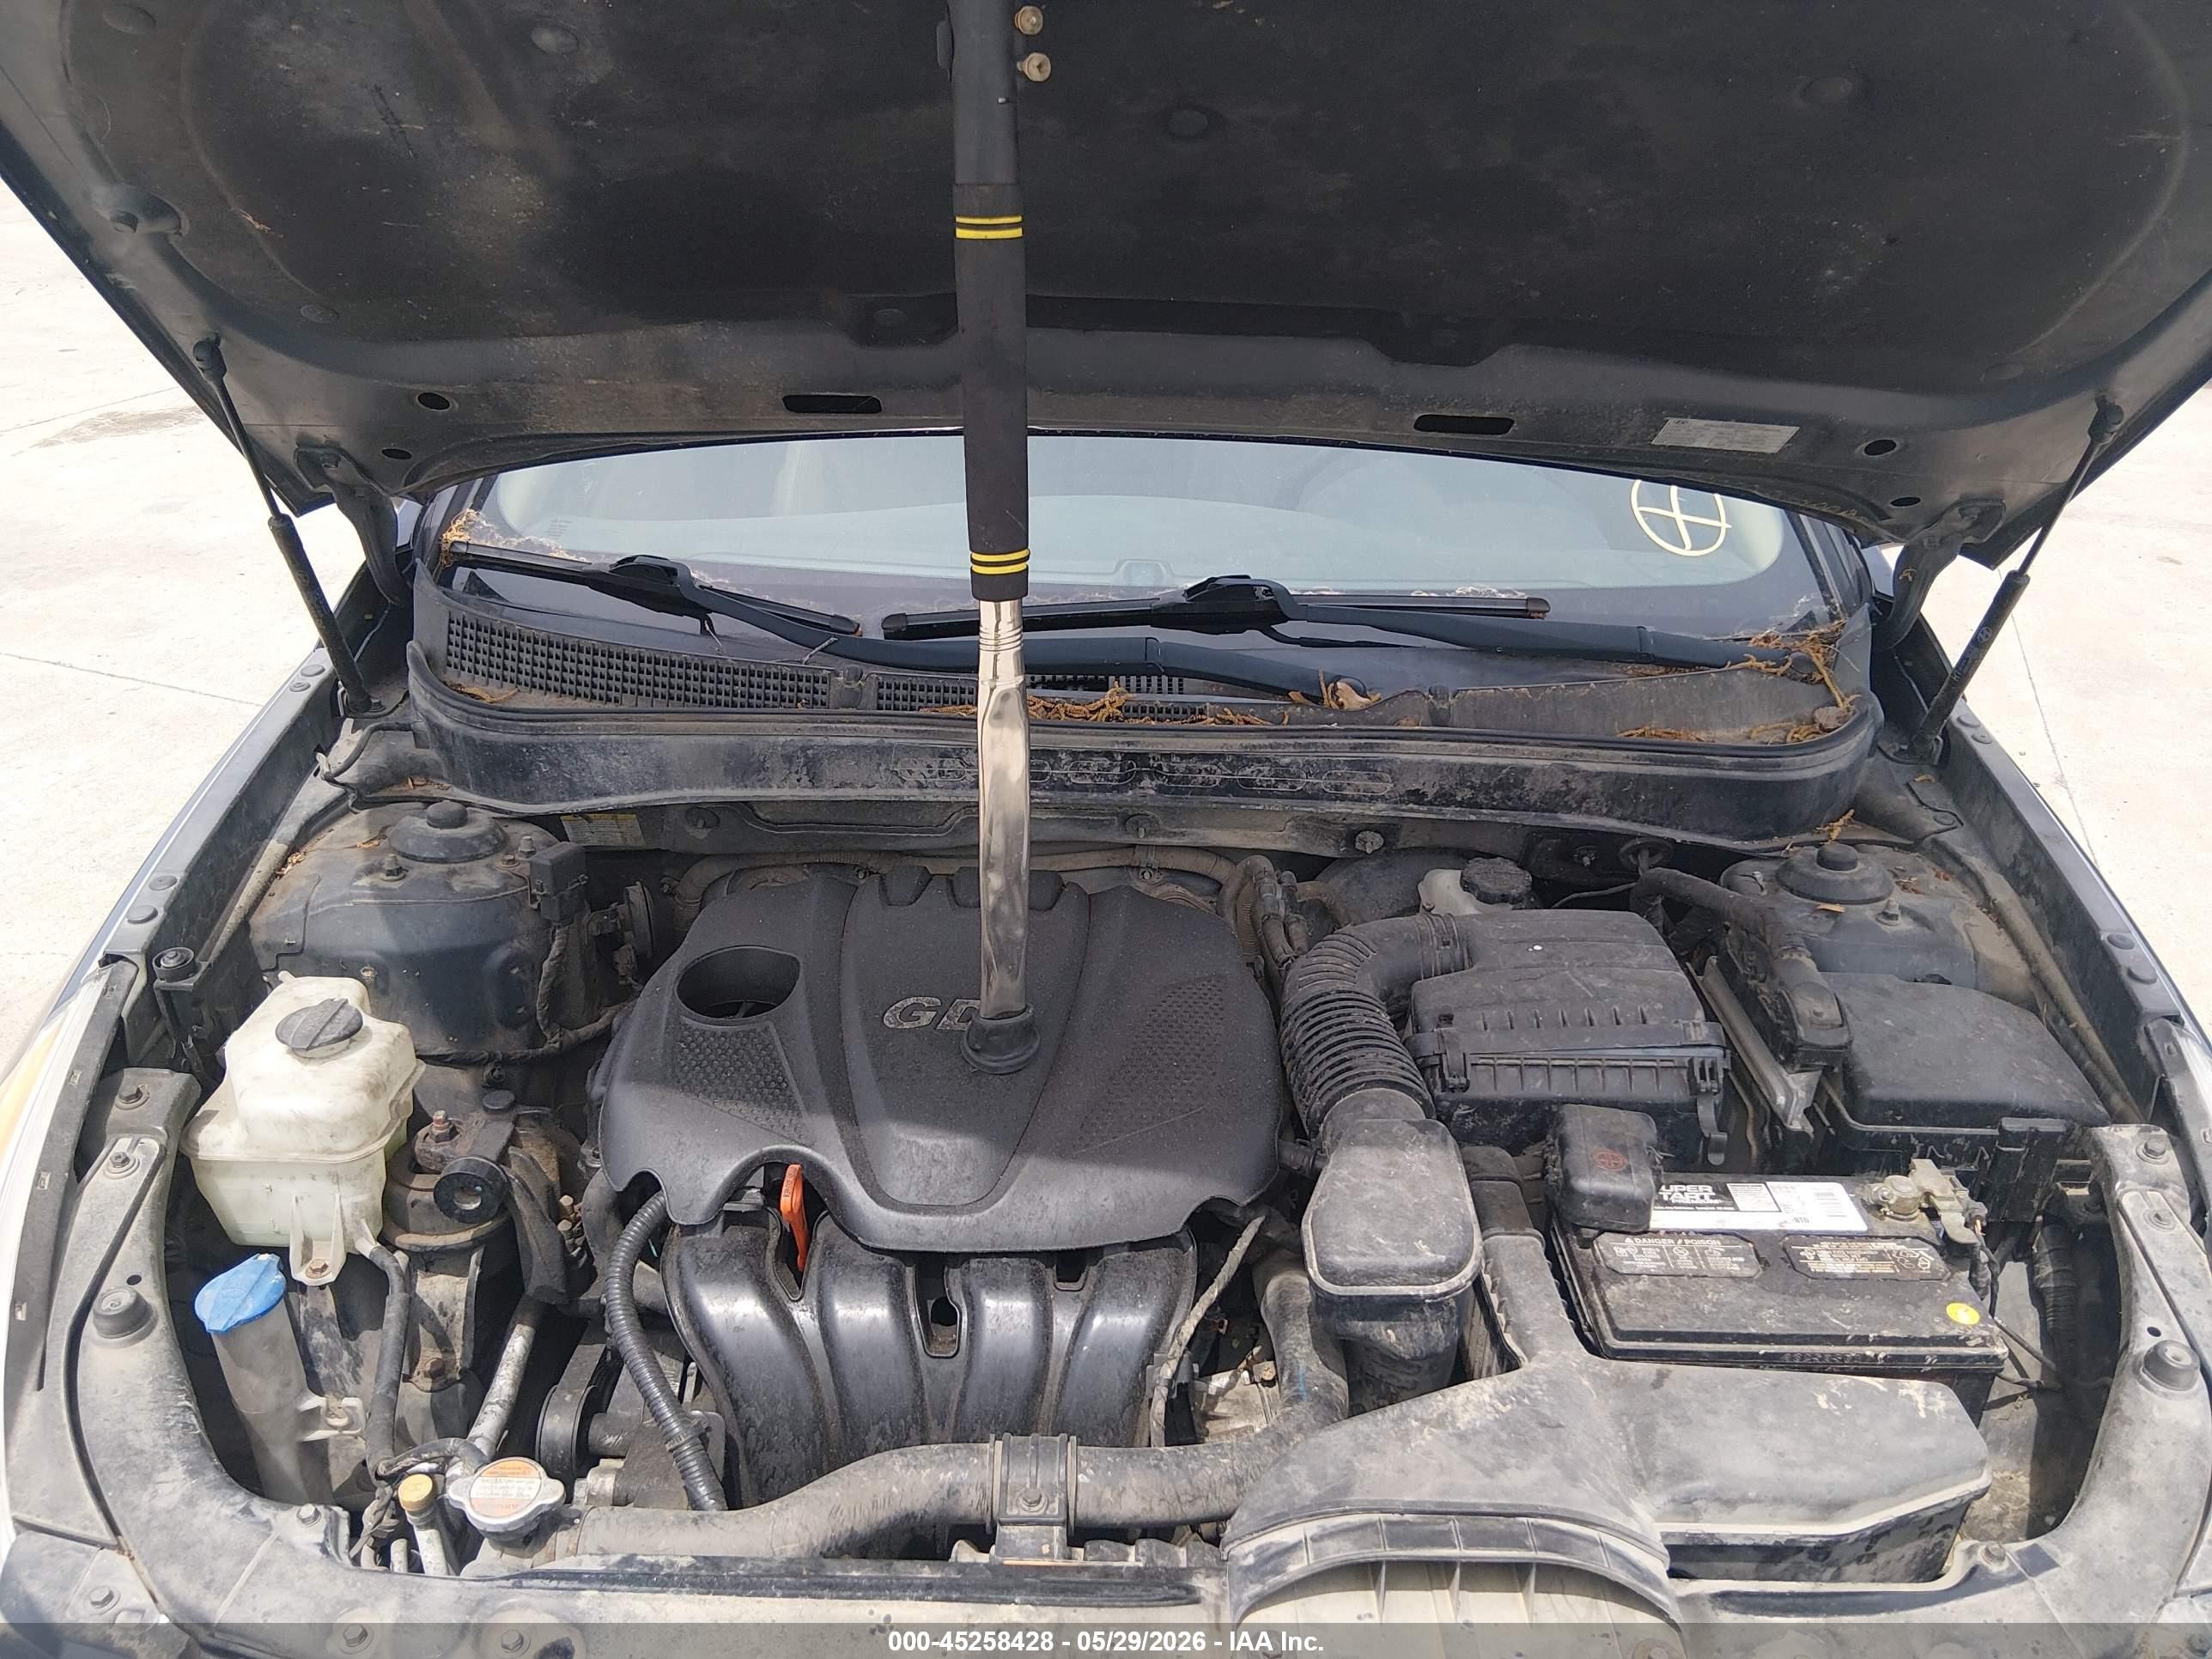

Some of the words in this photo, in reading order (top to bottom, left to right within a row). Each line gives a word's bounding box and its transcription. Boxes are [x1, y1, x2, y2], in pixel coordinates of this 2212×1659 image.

[883, 995, 981, 1031] GD
[1659, 1184, 1713, 1193] UPER
[1658, 1192, 1716, 1201] TART
